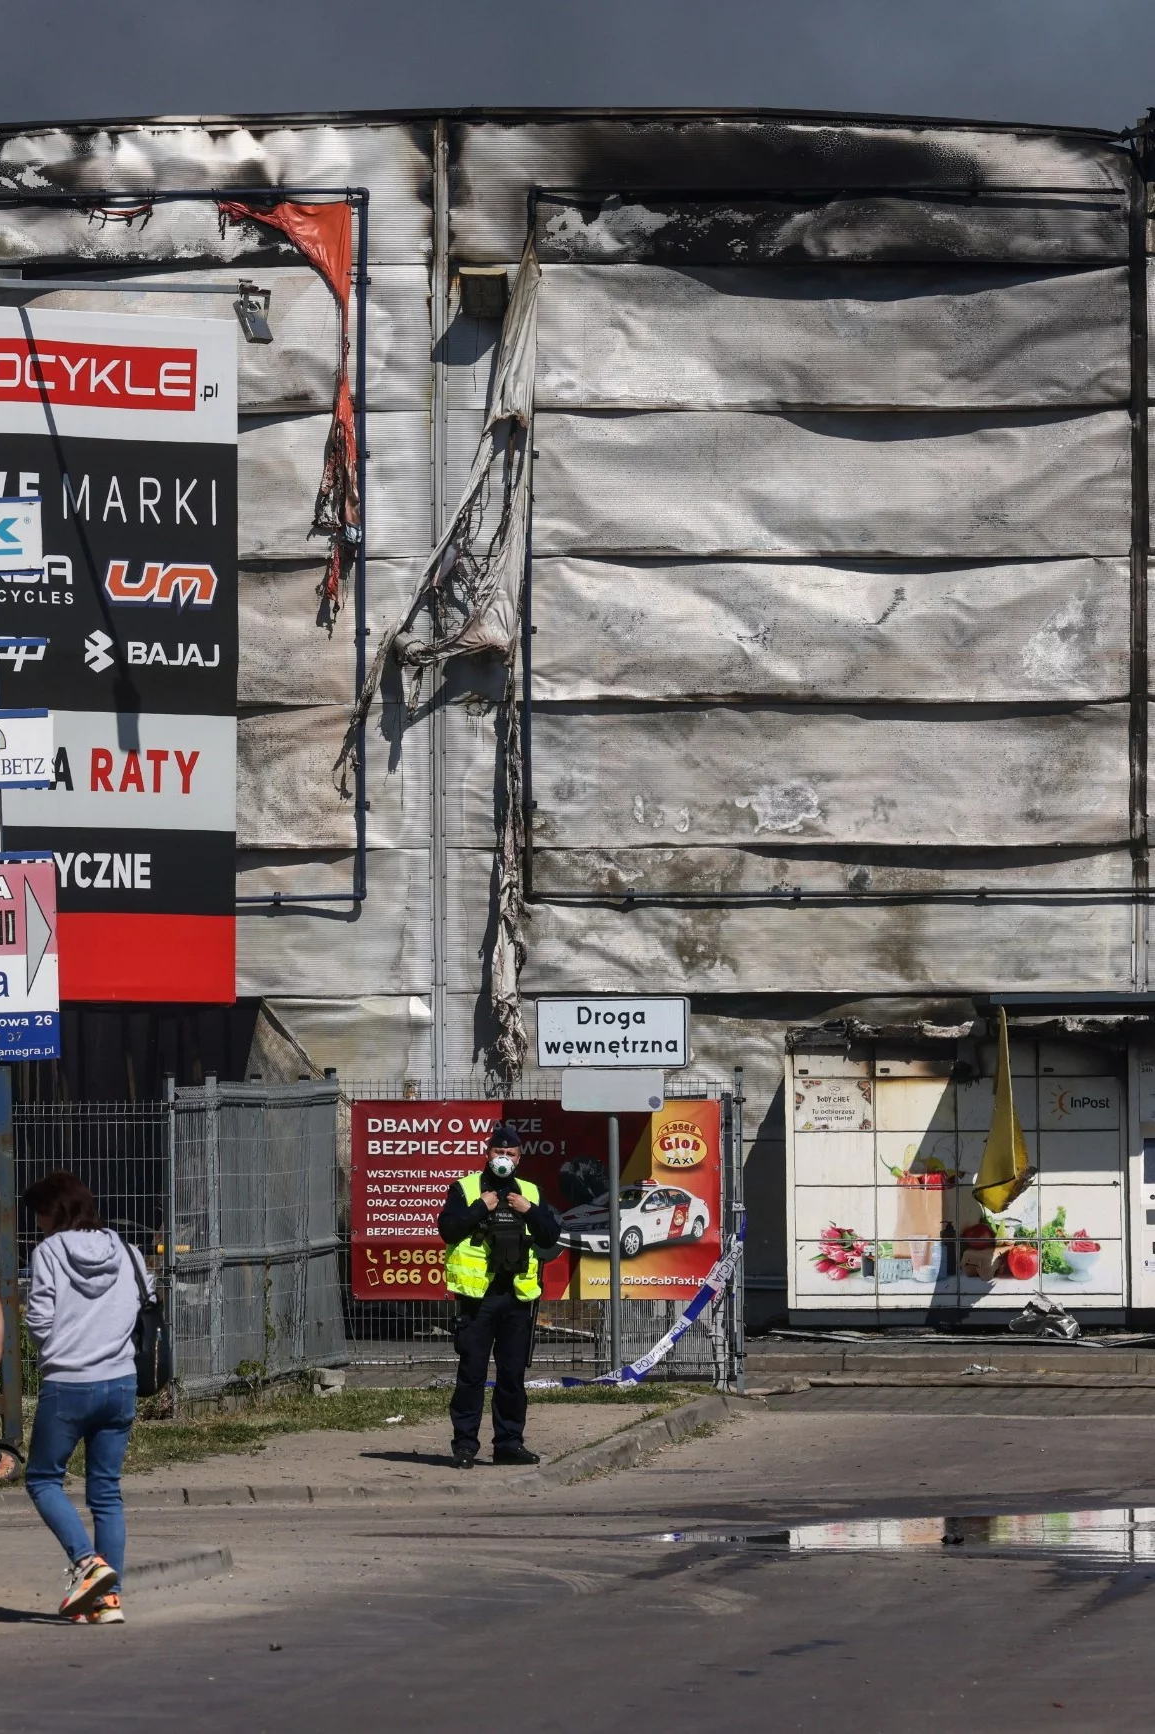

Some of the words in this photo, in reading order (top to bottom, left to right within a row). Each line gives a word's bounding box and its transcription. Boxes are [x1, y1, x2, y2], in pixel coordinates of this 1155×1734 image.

[62, 473, 218, 526] MARKI
[127, 642, 220, 668] BAJAJ
[1, 757, 45, 776] BETZ
[90, 746, 200, 795] RATY
[34, 1015, 53, 1027] 26
[577, 1006, 646, 1030] Droga
[545, 1036, 678, 1058] wewnętrzna
[1070, 1097, 1110, 1109] InPost
[368, 1118, 443, 1133] DBAMY
[448, 1118, 464, 1133] O
[368, 1137, 554, 1156] BEZPIECZEŃWO
[659, 1136, 701, 1151] Glob
[367, 1170, 427, 1178] WSZYSTKIE
[430, 1170, 464, 1178] NASZE
[367, 1184, 382, 1194] SĄ
[367, 1199, 397, 1207] ORAZ
[366, 1213, 370, 1221] I
[373, 1213, 434, 1224] POSIADAJĄ
[712, 1245, 743, 1284] POLICJA
[383, 1268, 422, 1284] 666
